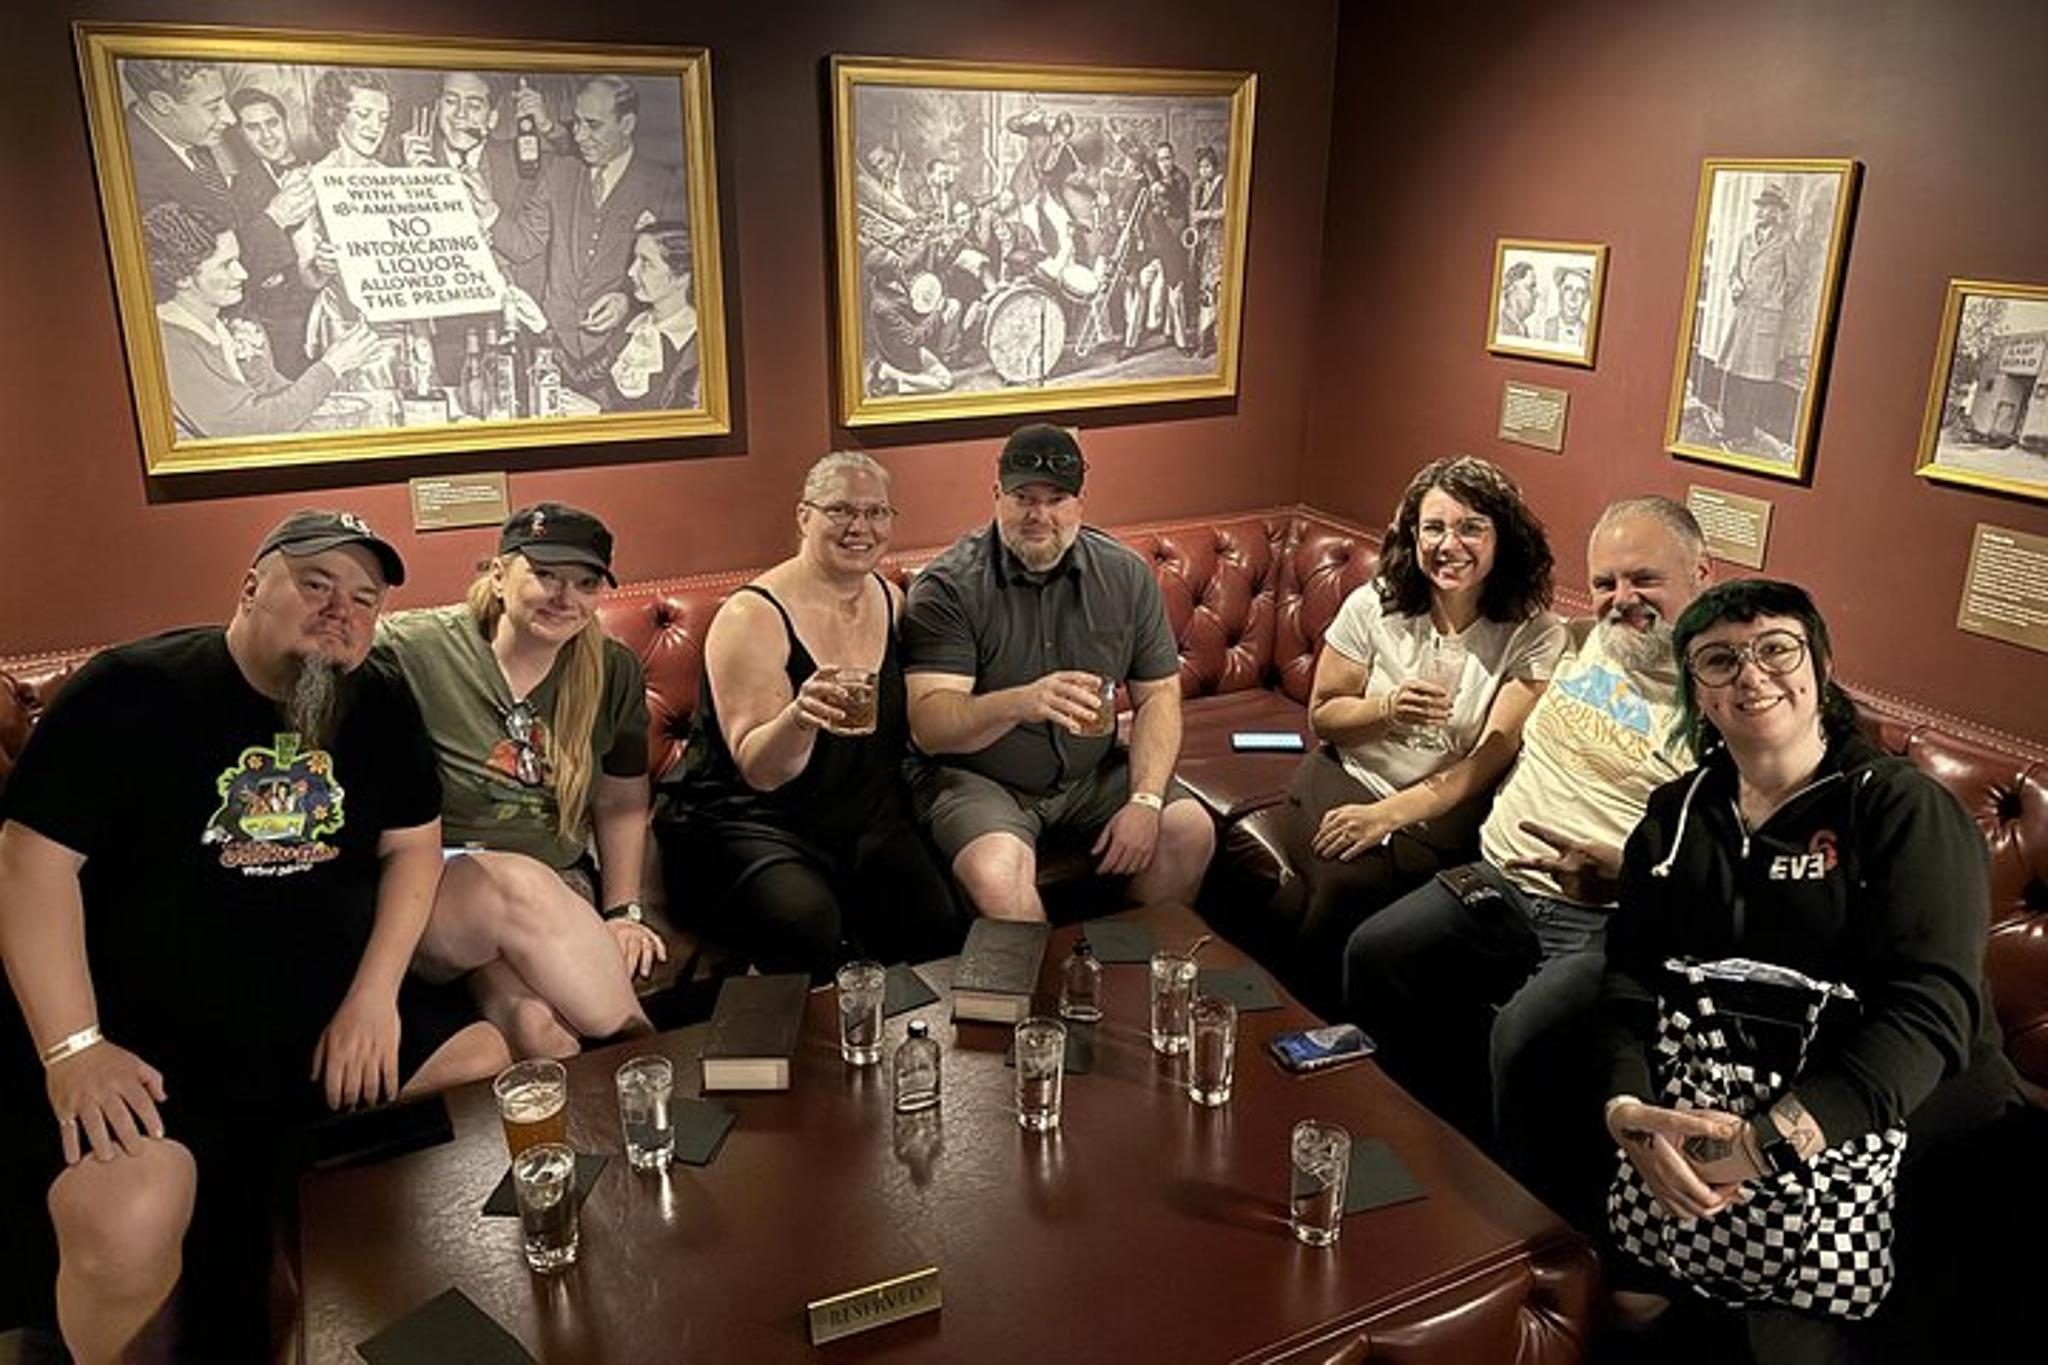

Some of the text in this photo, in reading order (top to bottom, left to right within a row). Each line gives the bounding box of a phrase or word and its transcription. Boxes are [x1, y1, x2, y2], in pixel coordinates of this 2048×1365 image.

[324, 174, 455, 187] IN COMPLIANCE
[347, 187, 437, 200] WITH THE
[362, 201, 464, 214] AMENDMENT
[387, 216, 431, 238] NO
[347, 235, 479, 257] INTOXICATING
[376, 256, 470, 275] LIQUOR
[361, 271, 487, 292] ALLOWED ON
[363, 288, 496, 309] THE PREMISES
[829, 1286, 925, 1326] RESERVED
